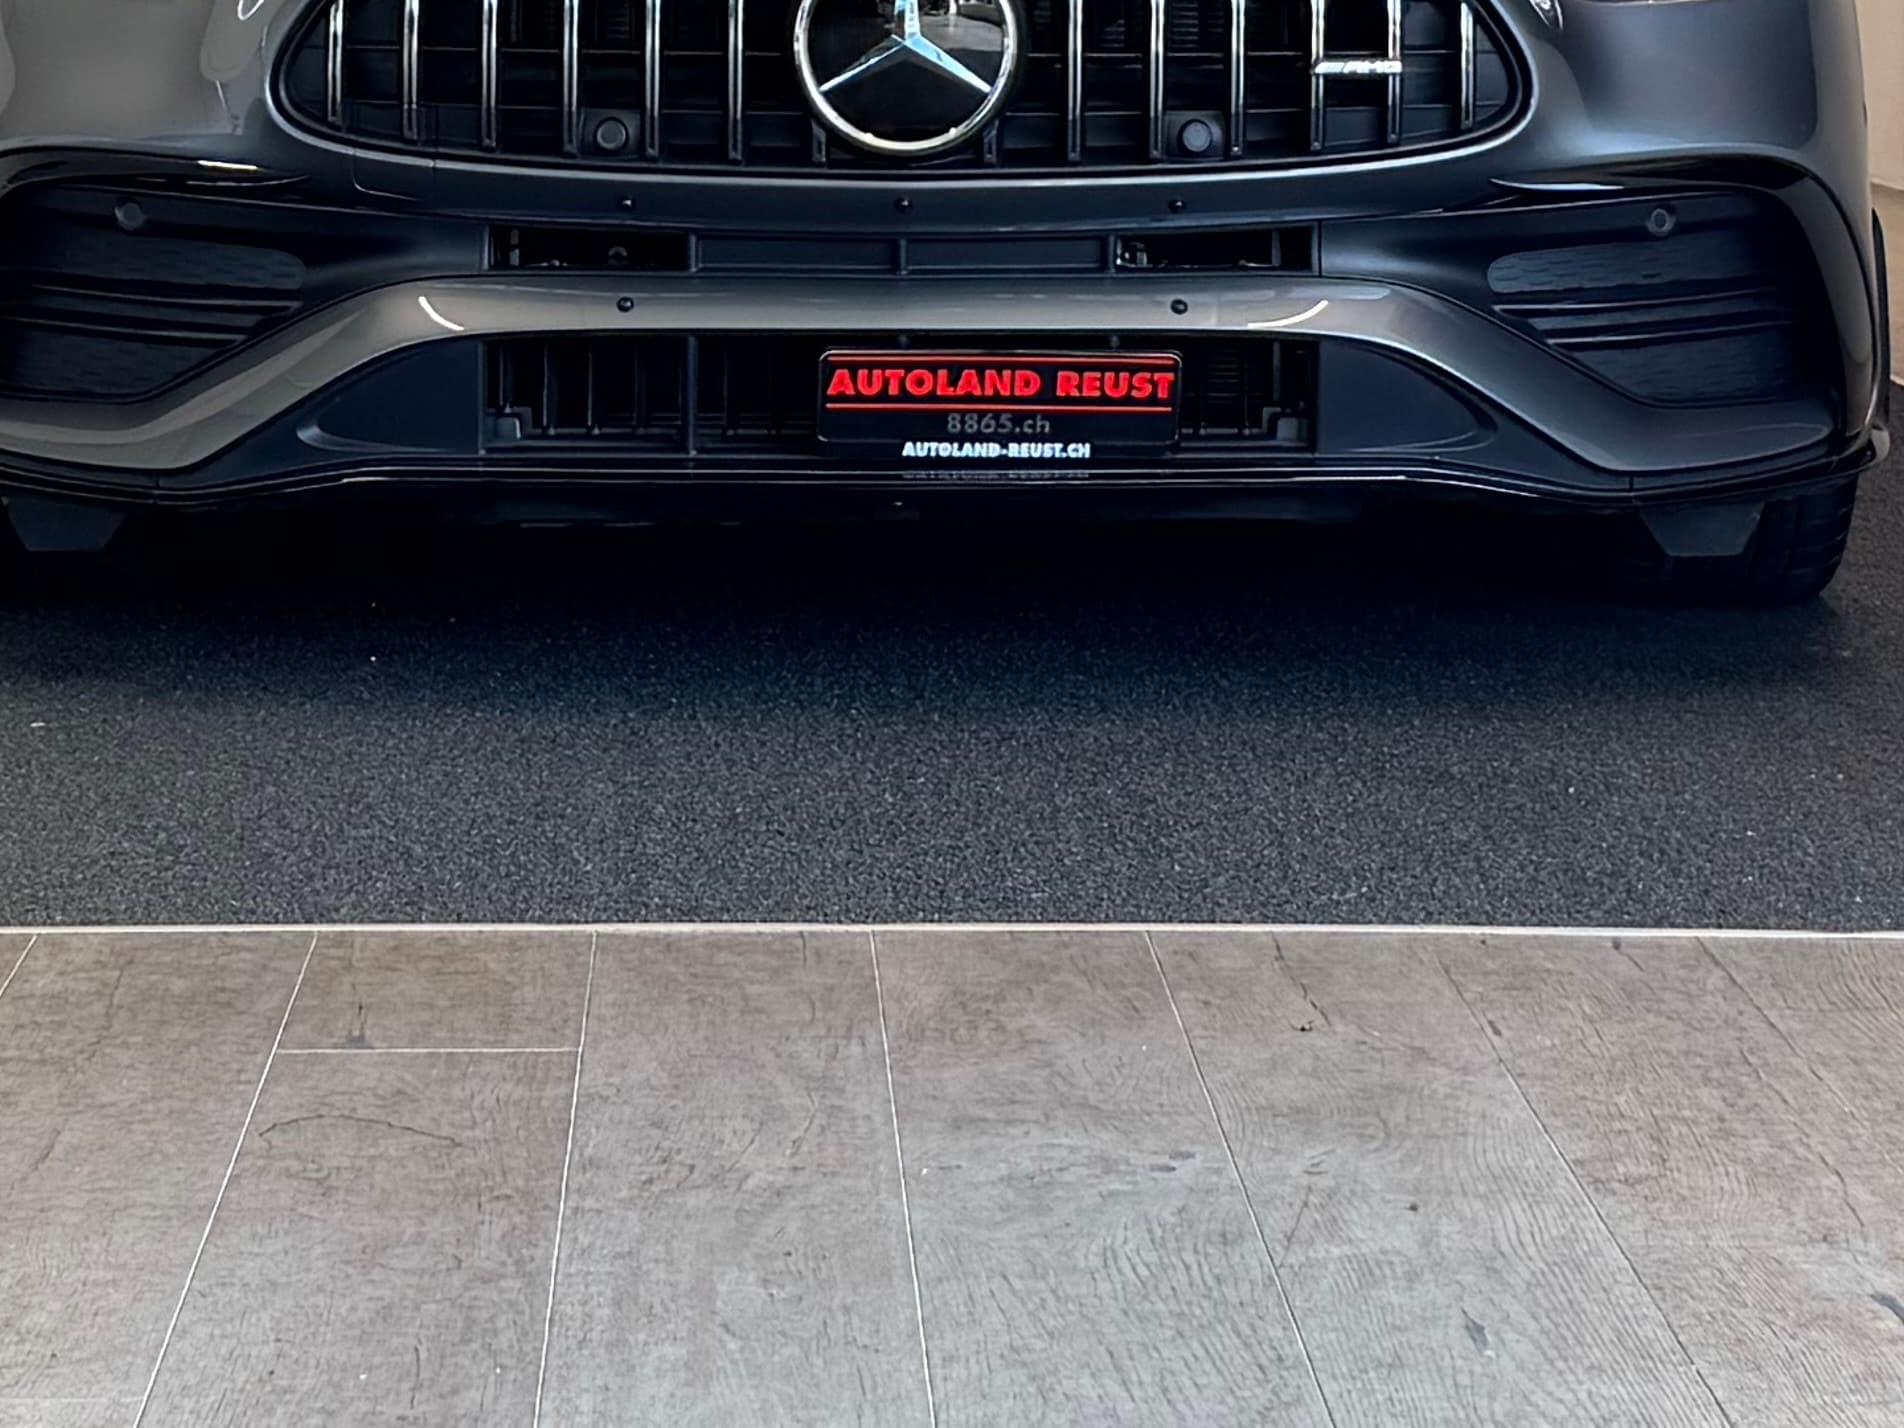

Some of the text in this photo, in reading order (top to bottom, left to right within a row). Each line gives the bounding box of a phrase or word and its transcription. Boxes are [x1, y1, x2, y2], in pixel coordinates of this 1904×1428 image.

[826, 367, 1176, 401] AUTOLAND REUST
[946, 412, 1051, 434] 8865.ch
[902, 441, 1091, 458] AUTOLAND-REUST.CH
